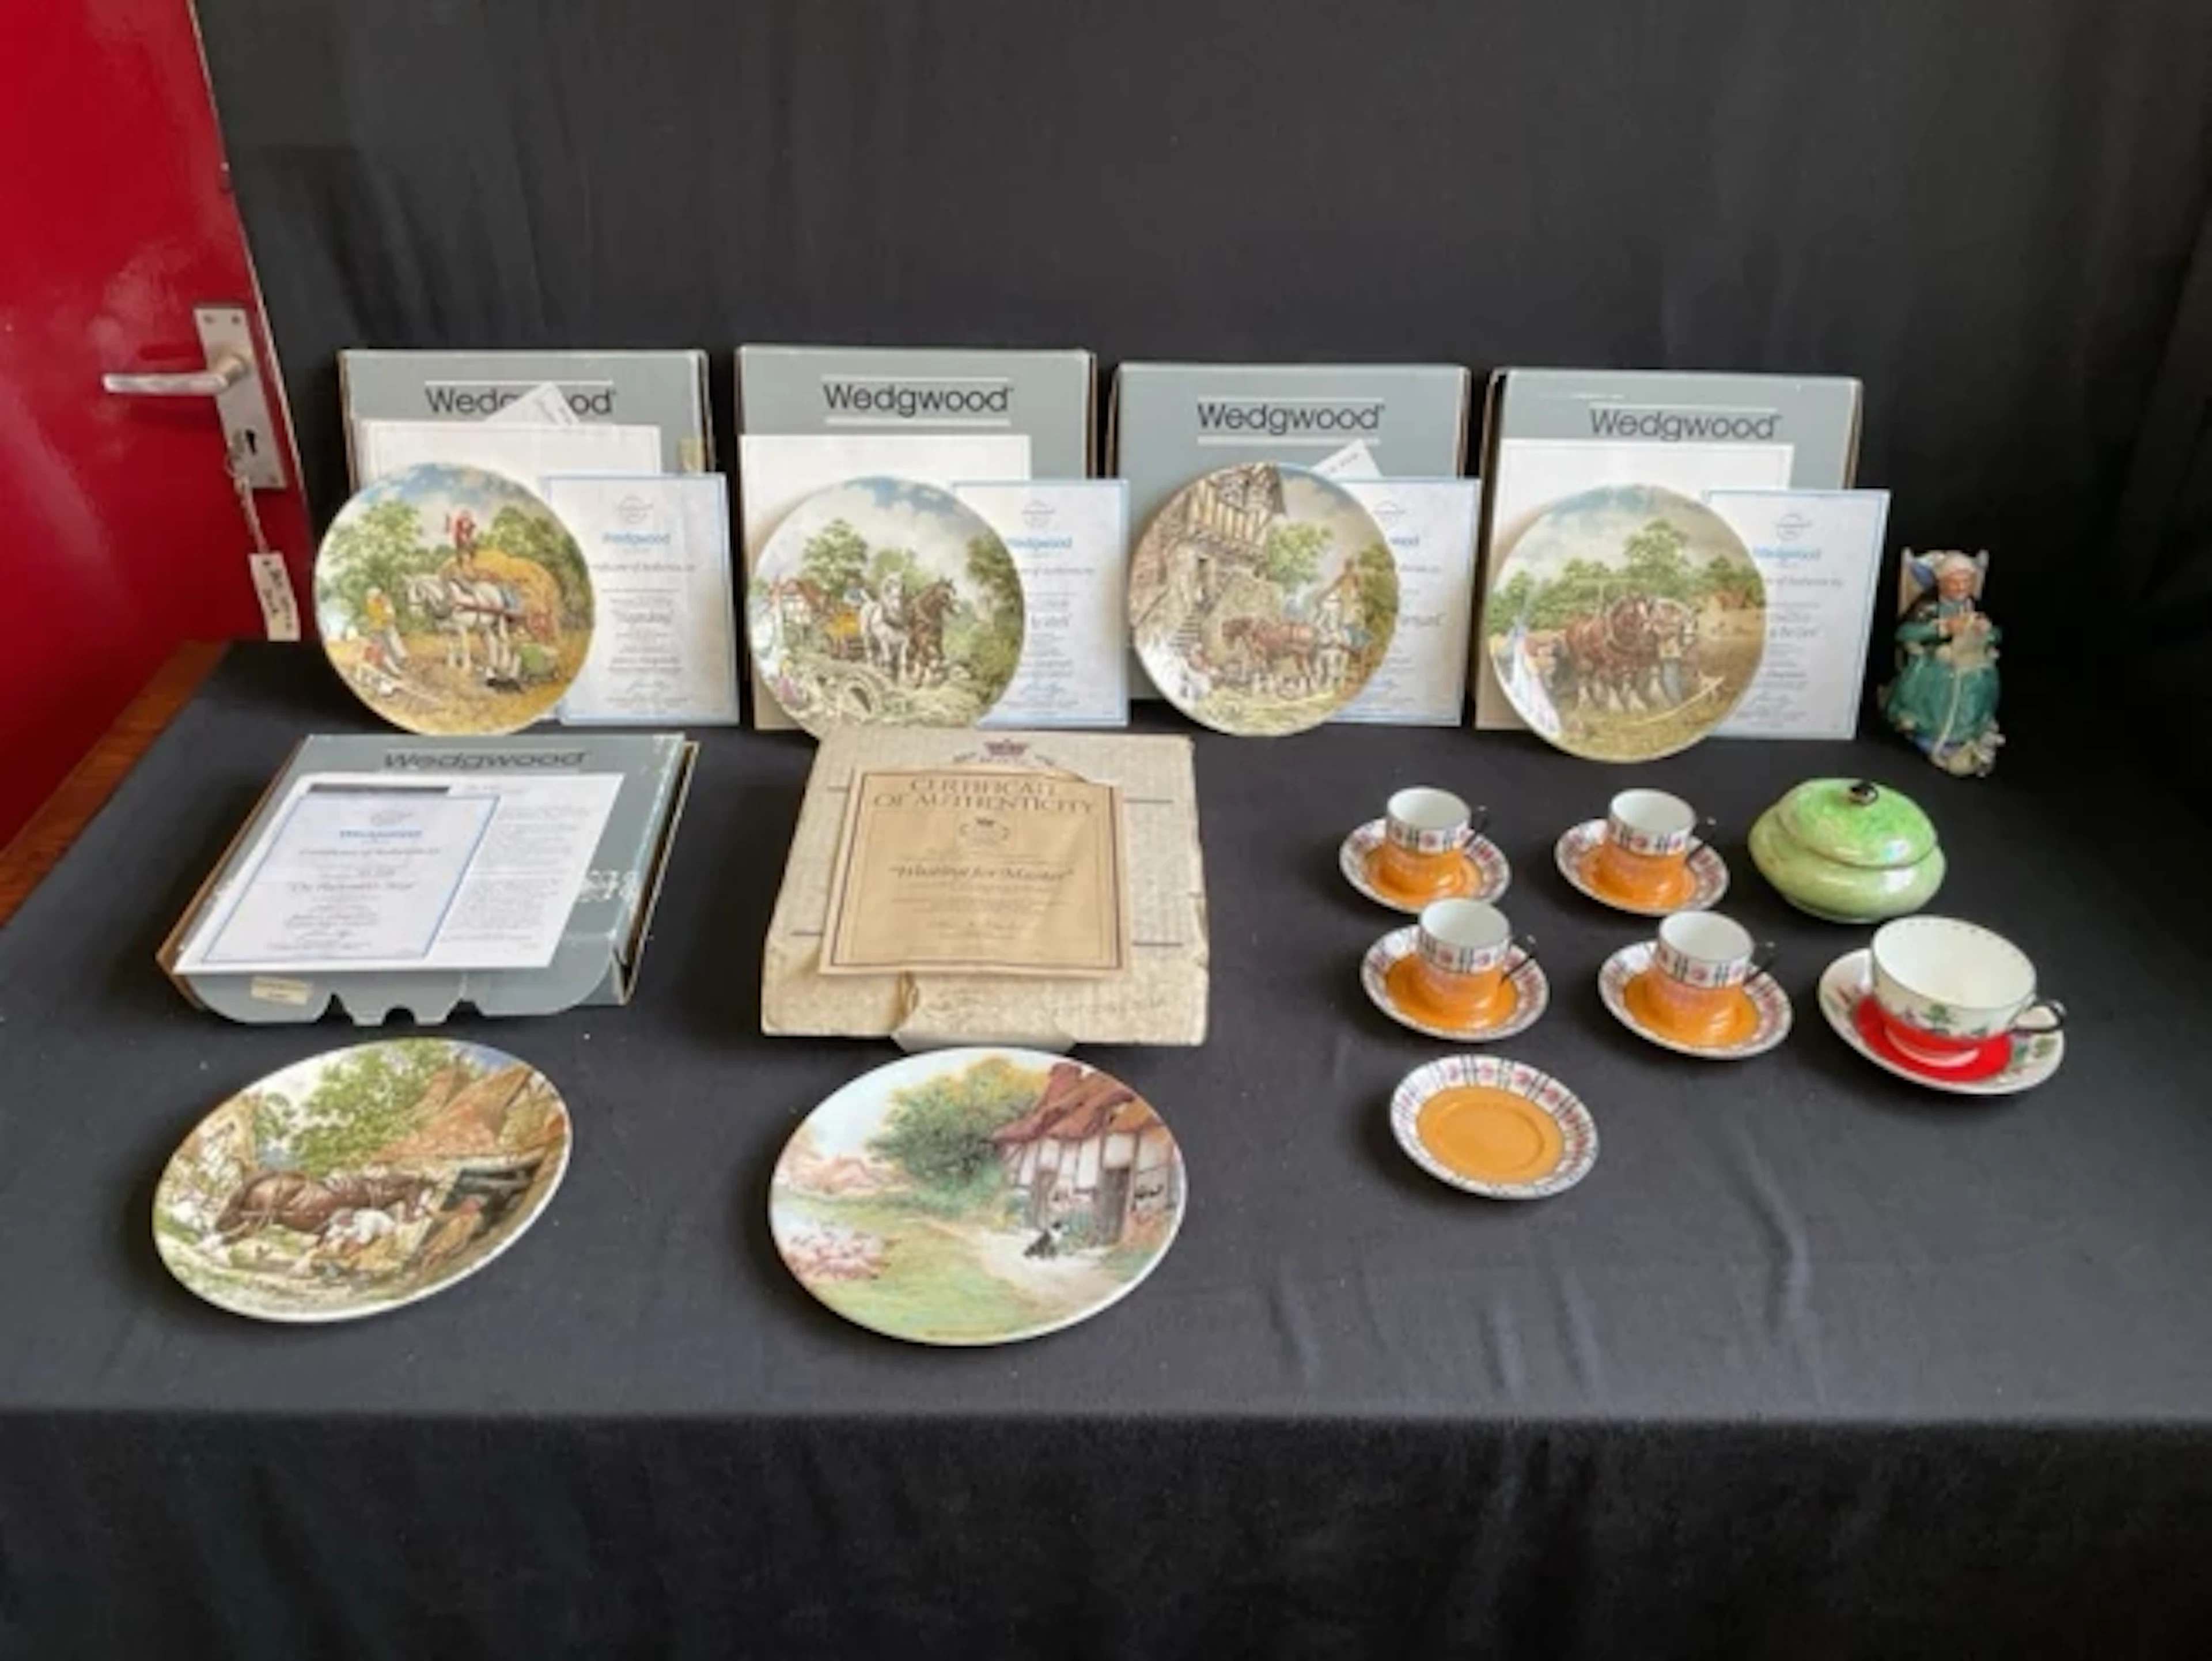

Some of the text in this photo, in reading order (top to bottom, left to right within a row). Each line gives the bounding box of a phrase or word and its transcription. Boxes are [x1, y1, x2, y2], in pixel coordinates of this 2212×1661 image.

[425, 387, 612, 416] Wedod
[823, 384, 1009, 419] Wedgwood
[1197, 404, 1380, 435] Wedgwood
[1590, 409, 1778, 442] Wedgwood
[384, 751, 586, 770] Wedgwood
